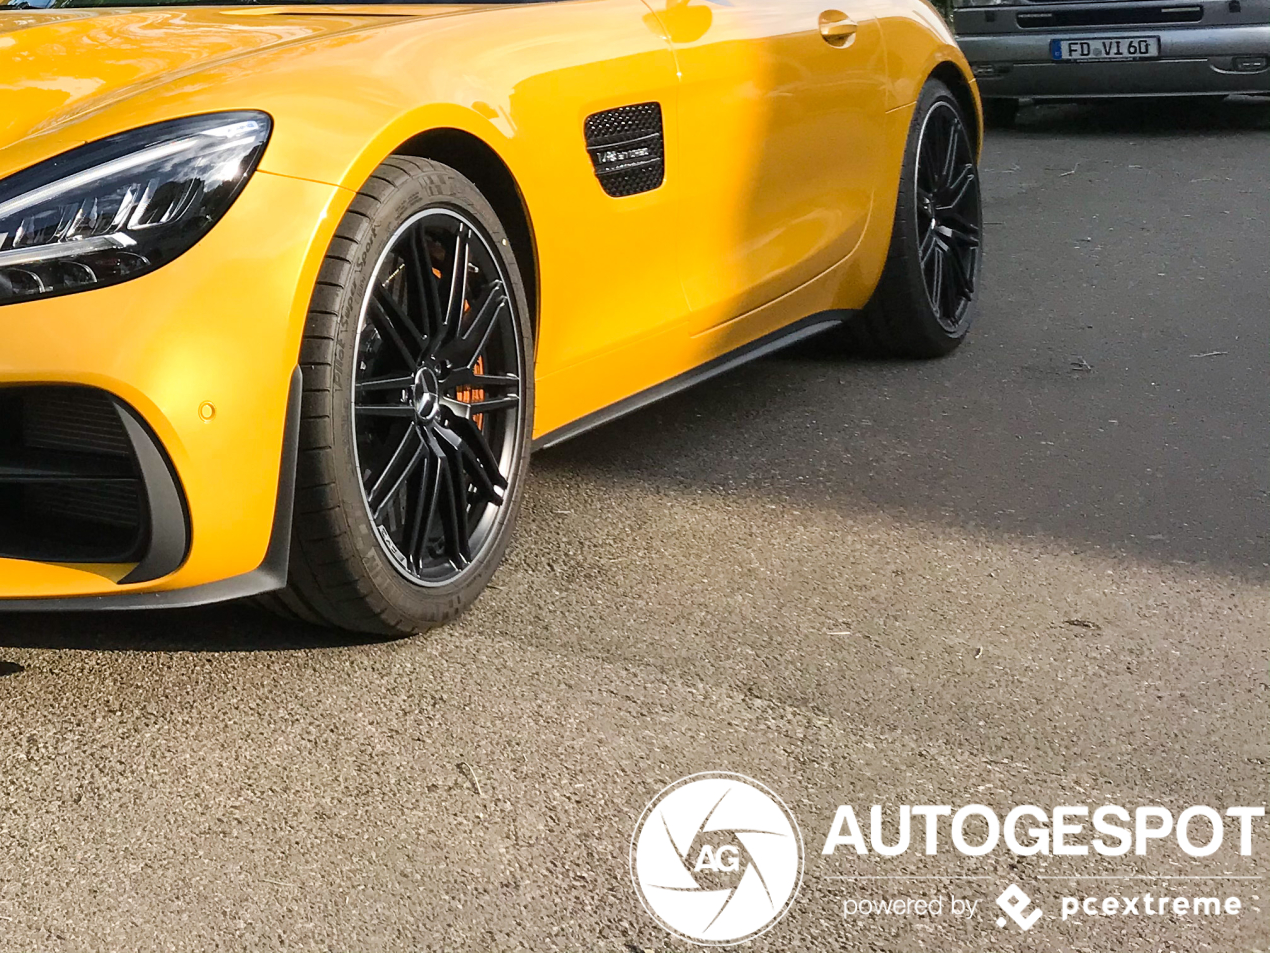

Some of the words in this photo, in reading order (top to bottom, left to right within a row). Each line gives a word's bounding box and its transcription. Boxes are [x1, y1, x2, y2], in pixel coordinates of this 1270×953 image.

[1068, 42, 1091, 56] FD
[1102, 41, 1123, 55] VI
[1127, 40, 1150, 54] 60
[355, 224, 380, 270] Sport
